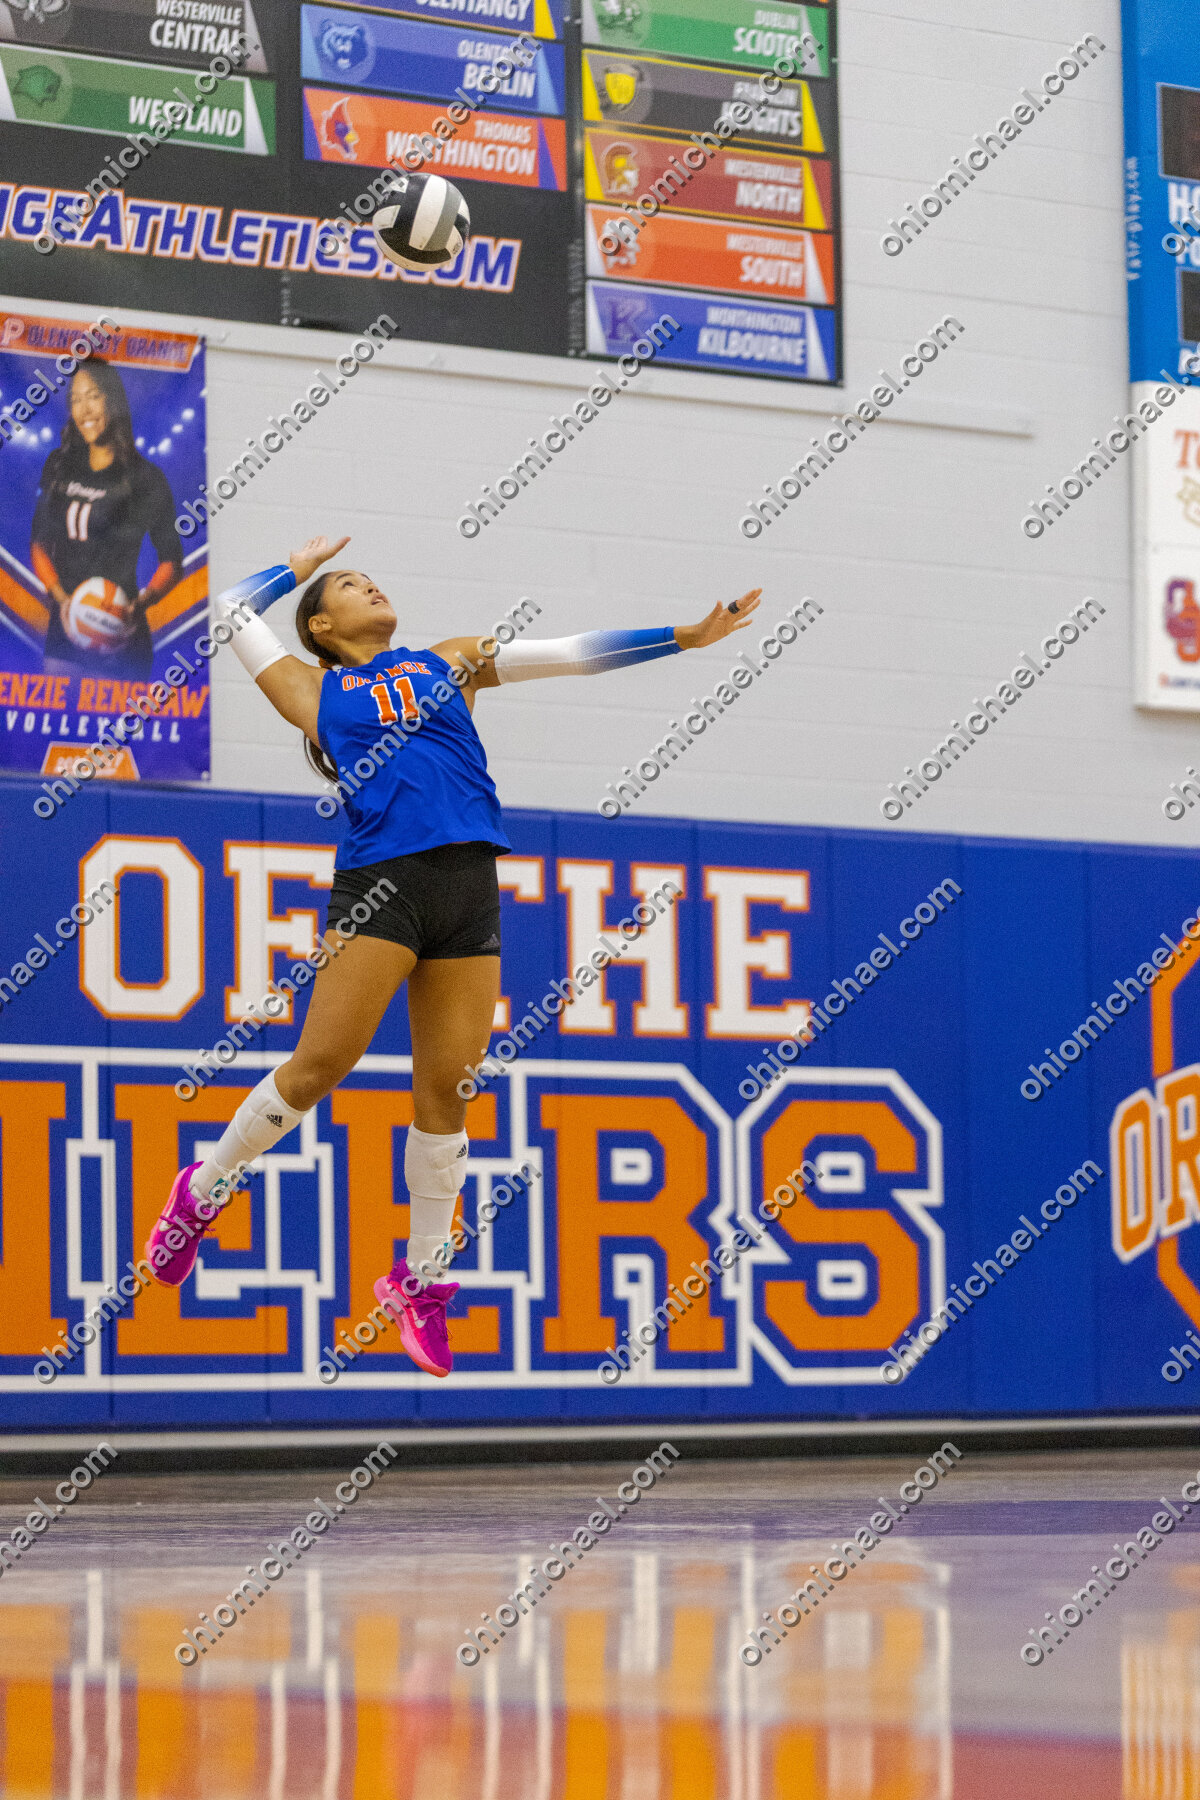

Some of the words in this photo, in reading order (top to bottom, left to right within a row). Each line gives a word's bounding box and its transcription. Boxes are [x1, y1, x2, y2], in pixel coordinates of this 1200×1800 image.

[156, 0, 242, 25] WESTERVILLE
[414, 0, 530, 22] TANGY
[150, 18, 242, 56] CENTRAL
[463, 62, 536, 98] BELIN
[735, 180, 803, 214] NORTH
[0, 182, 522, 293] GEATHLETICS.M
[739, 254, 804, 289] SOUTH
[697, 326, 805, 366] KILBOURNE
[370, 676, 420, 726] 11
[78, 833, 338, 1024] OF
